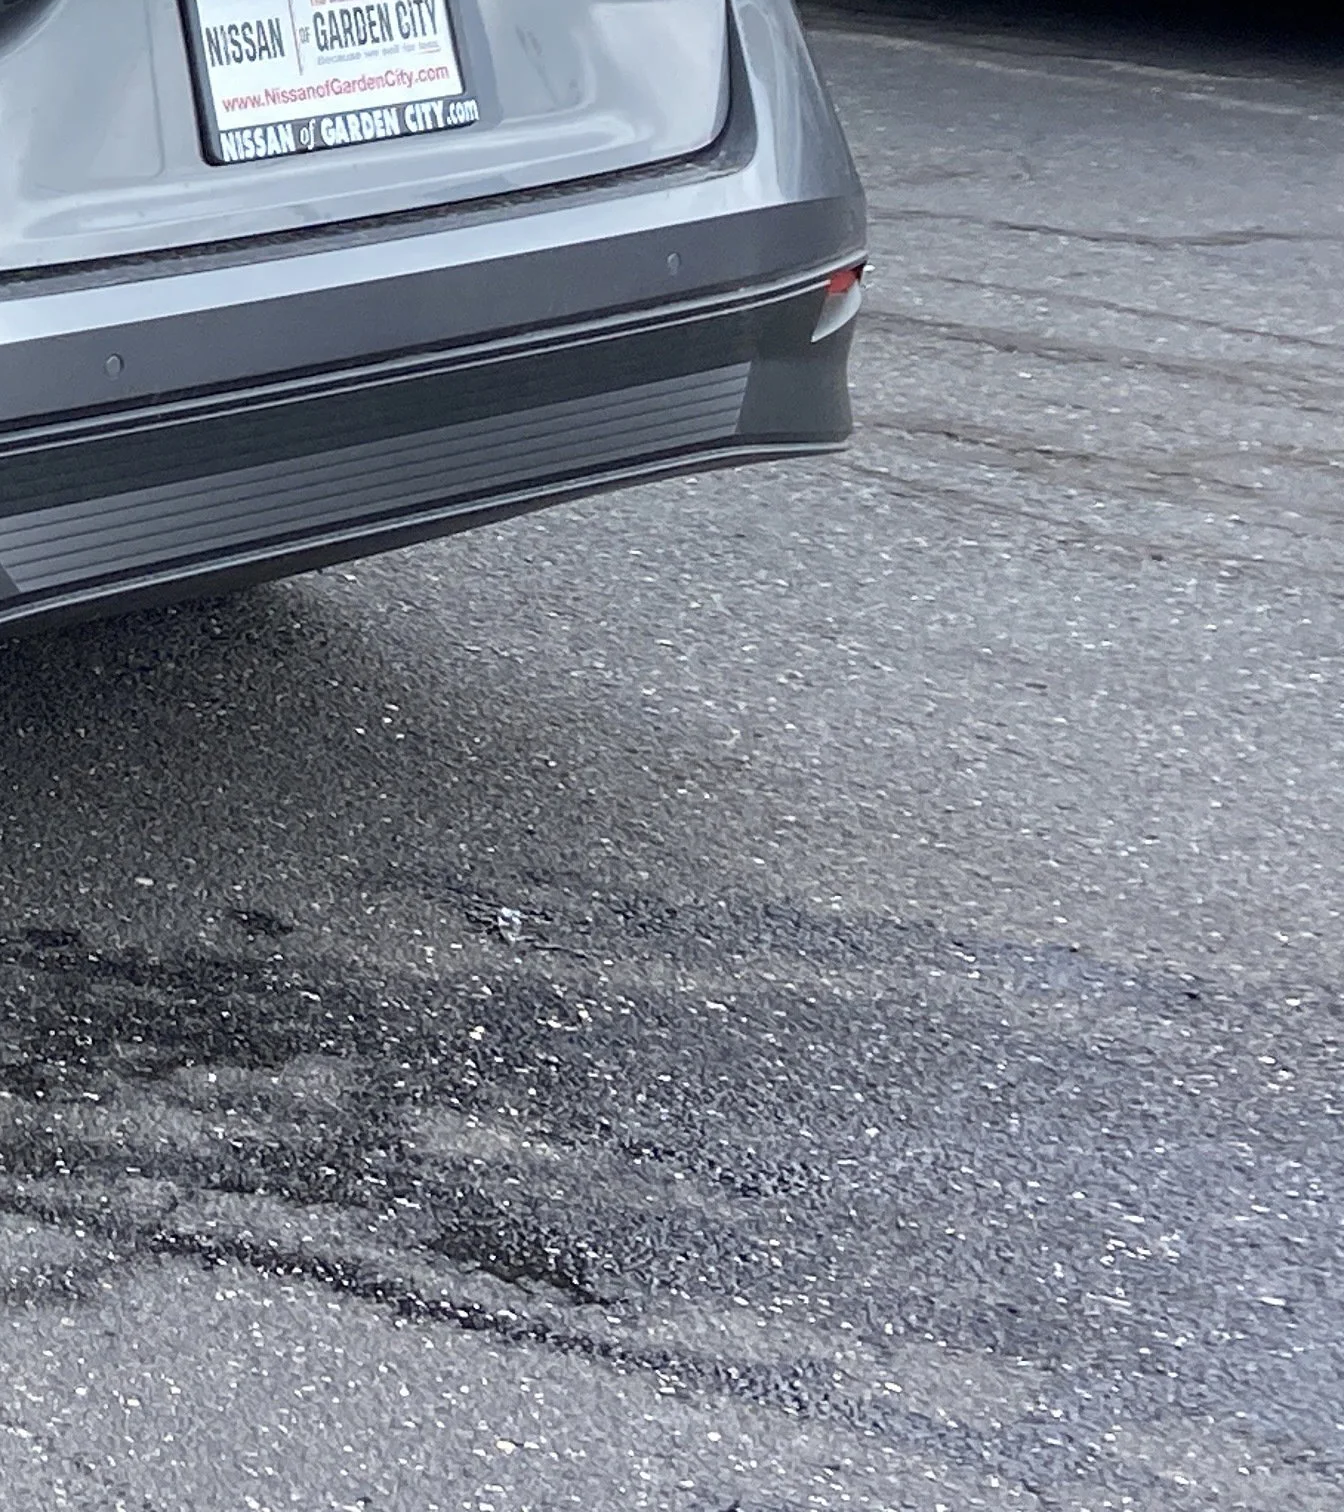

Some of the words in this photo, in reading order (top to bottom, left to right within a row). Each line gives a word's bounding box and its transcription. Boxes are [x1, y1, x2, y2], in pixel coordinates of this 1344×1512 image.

[205, 17, 285, 68] NISSAN
[312, 2, 394, 52] GARDEN
[222, 65, 451, 113] www.NissanofGardenCity.com
[220, 122, 296, 162] NISSAN
[299, 119, 318, 150] of
[320, 106, 402, 147] GARDEN
